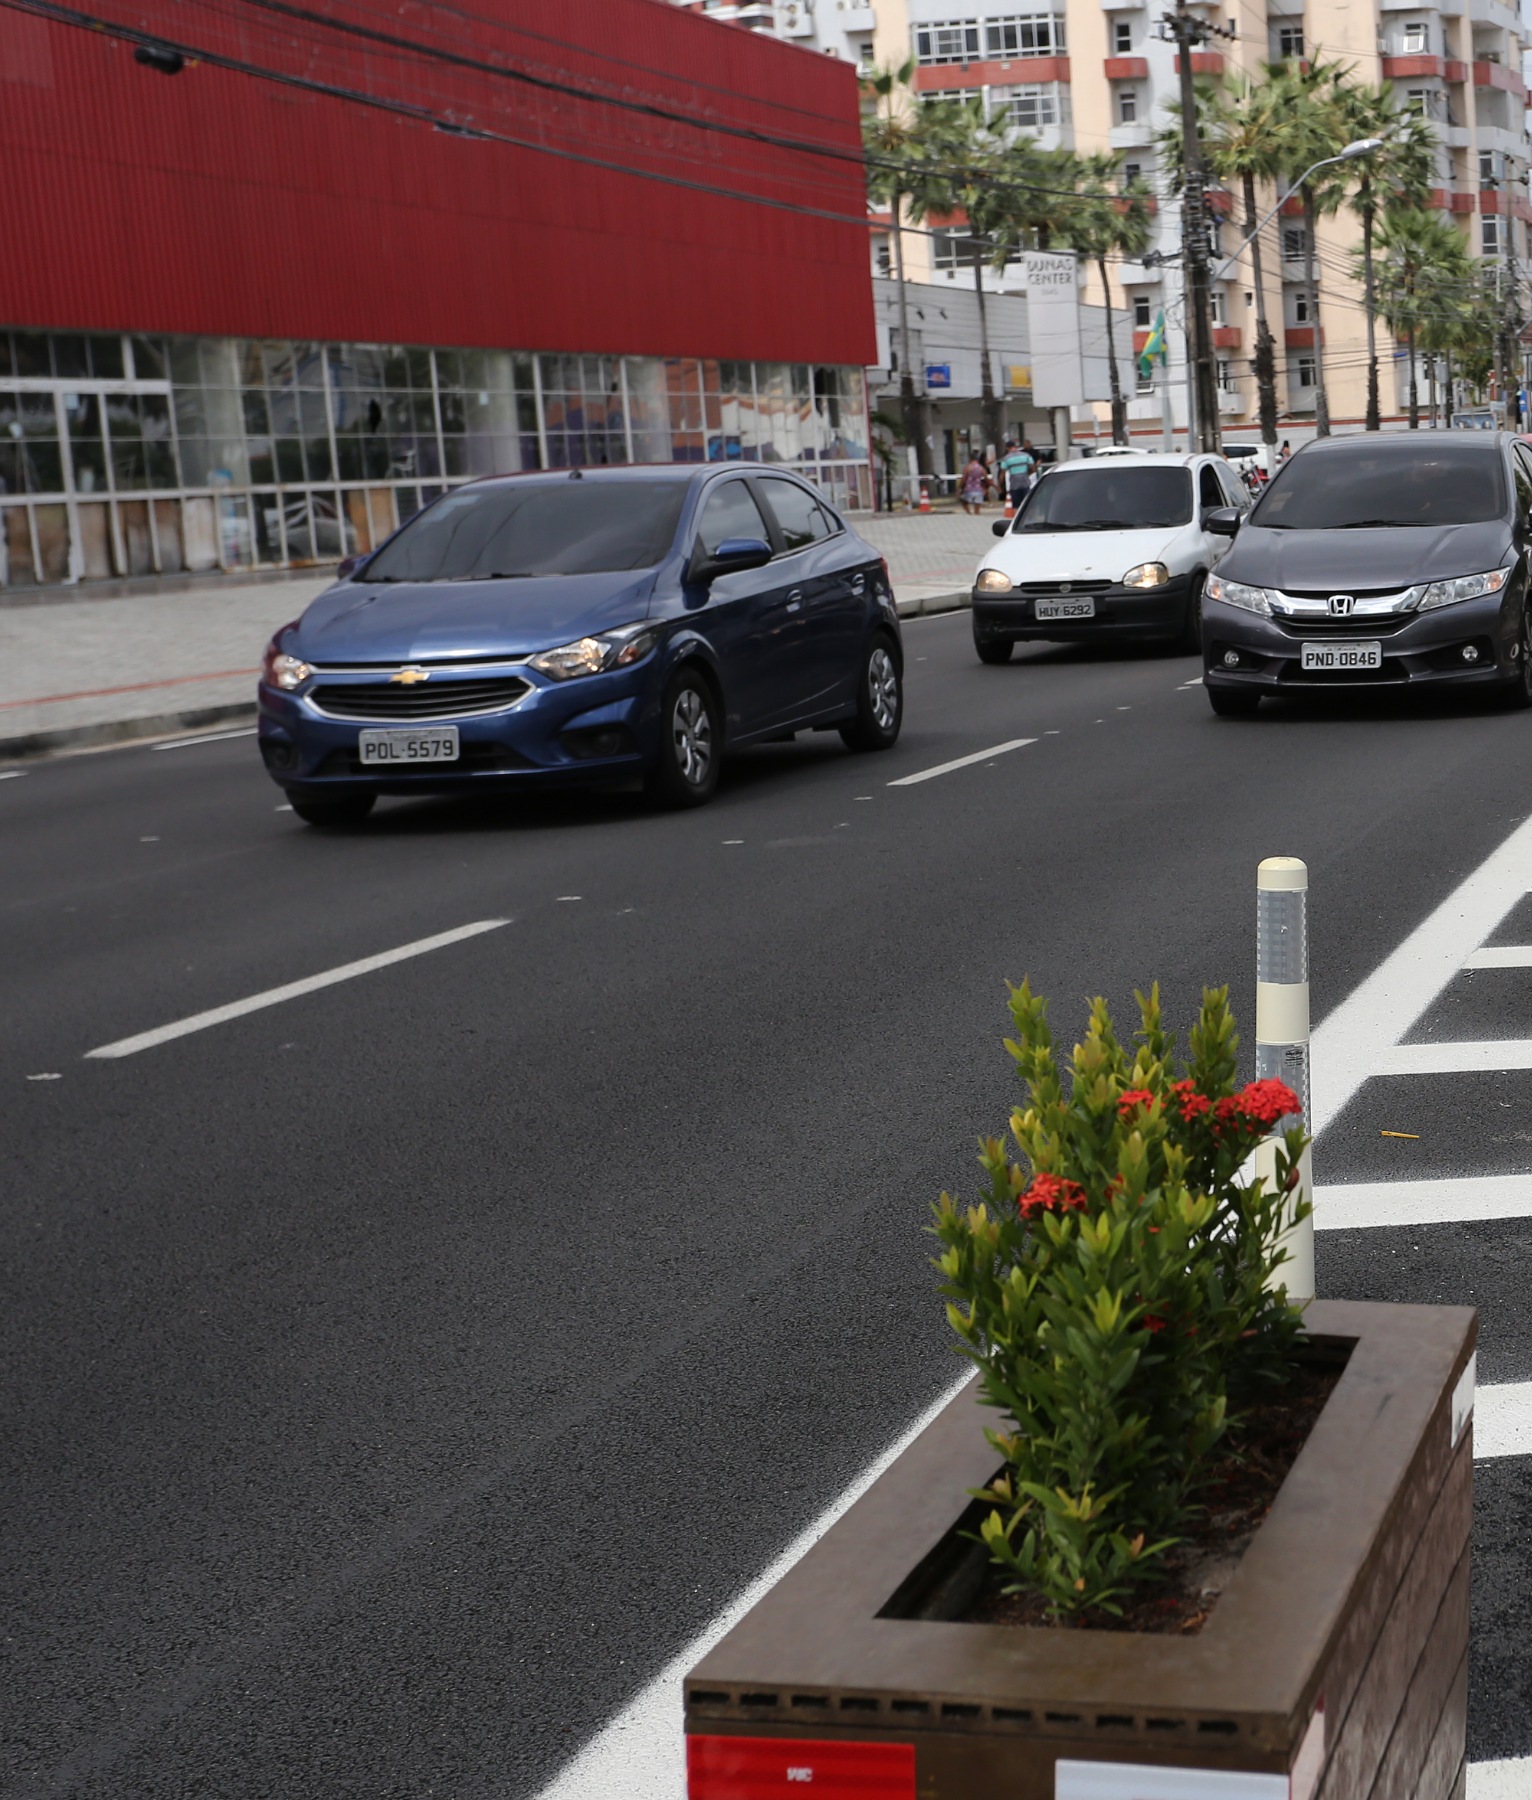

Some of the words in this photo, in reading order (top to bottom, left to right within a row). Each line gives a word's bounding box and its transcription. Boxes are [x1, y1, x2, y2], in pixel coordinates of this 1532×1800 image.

[1028, 273, 1072, 285] CENTER
[1039, 606, 1060, 617] HUY
[1063, 604, 1091, 616] 6292
